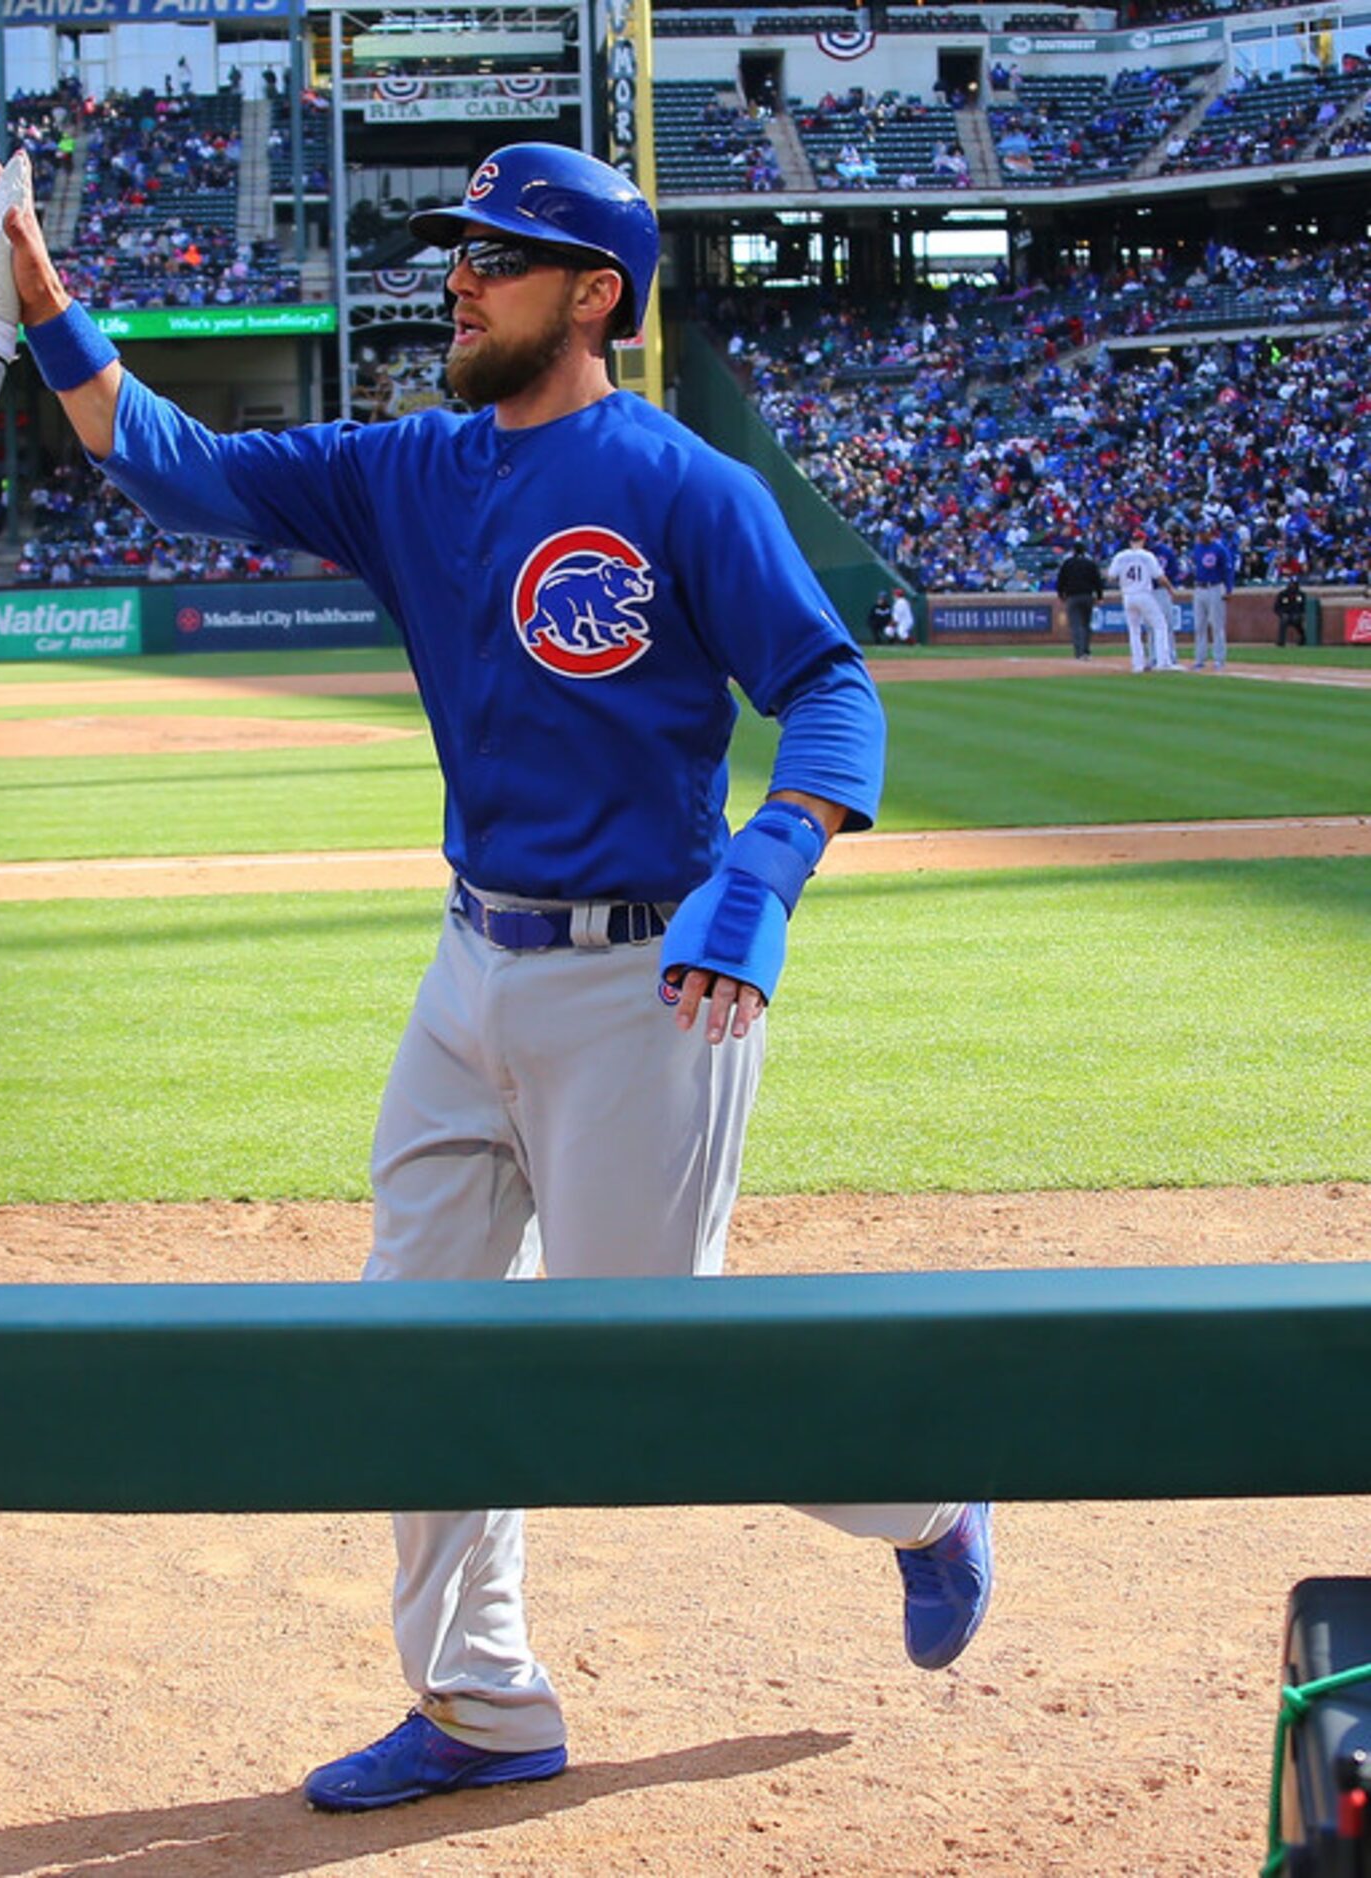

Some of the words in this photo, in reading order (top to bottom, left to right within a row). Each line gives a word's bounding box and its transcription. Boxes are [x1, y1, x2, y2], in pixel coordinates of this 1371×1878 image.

[465, 101, 556, 117] CABANA
[466, 163, 499, 201] C
[98, 318, 129, 334] Life
[213, 317, 244, 332] your
[1126, 566, 1143, 582] 41
[203, 610, 261, 627] Medical
[262, 610, 293, 629] City
[295, 608, 376, 625] Healthcare
[35, 636, 64, 652] Car
[69, 634, 127, 651] Rental
